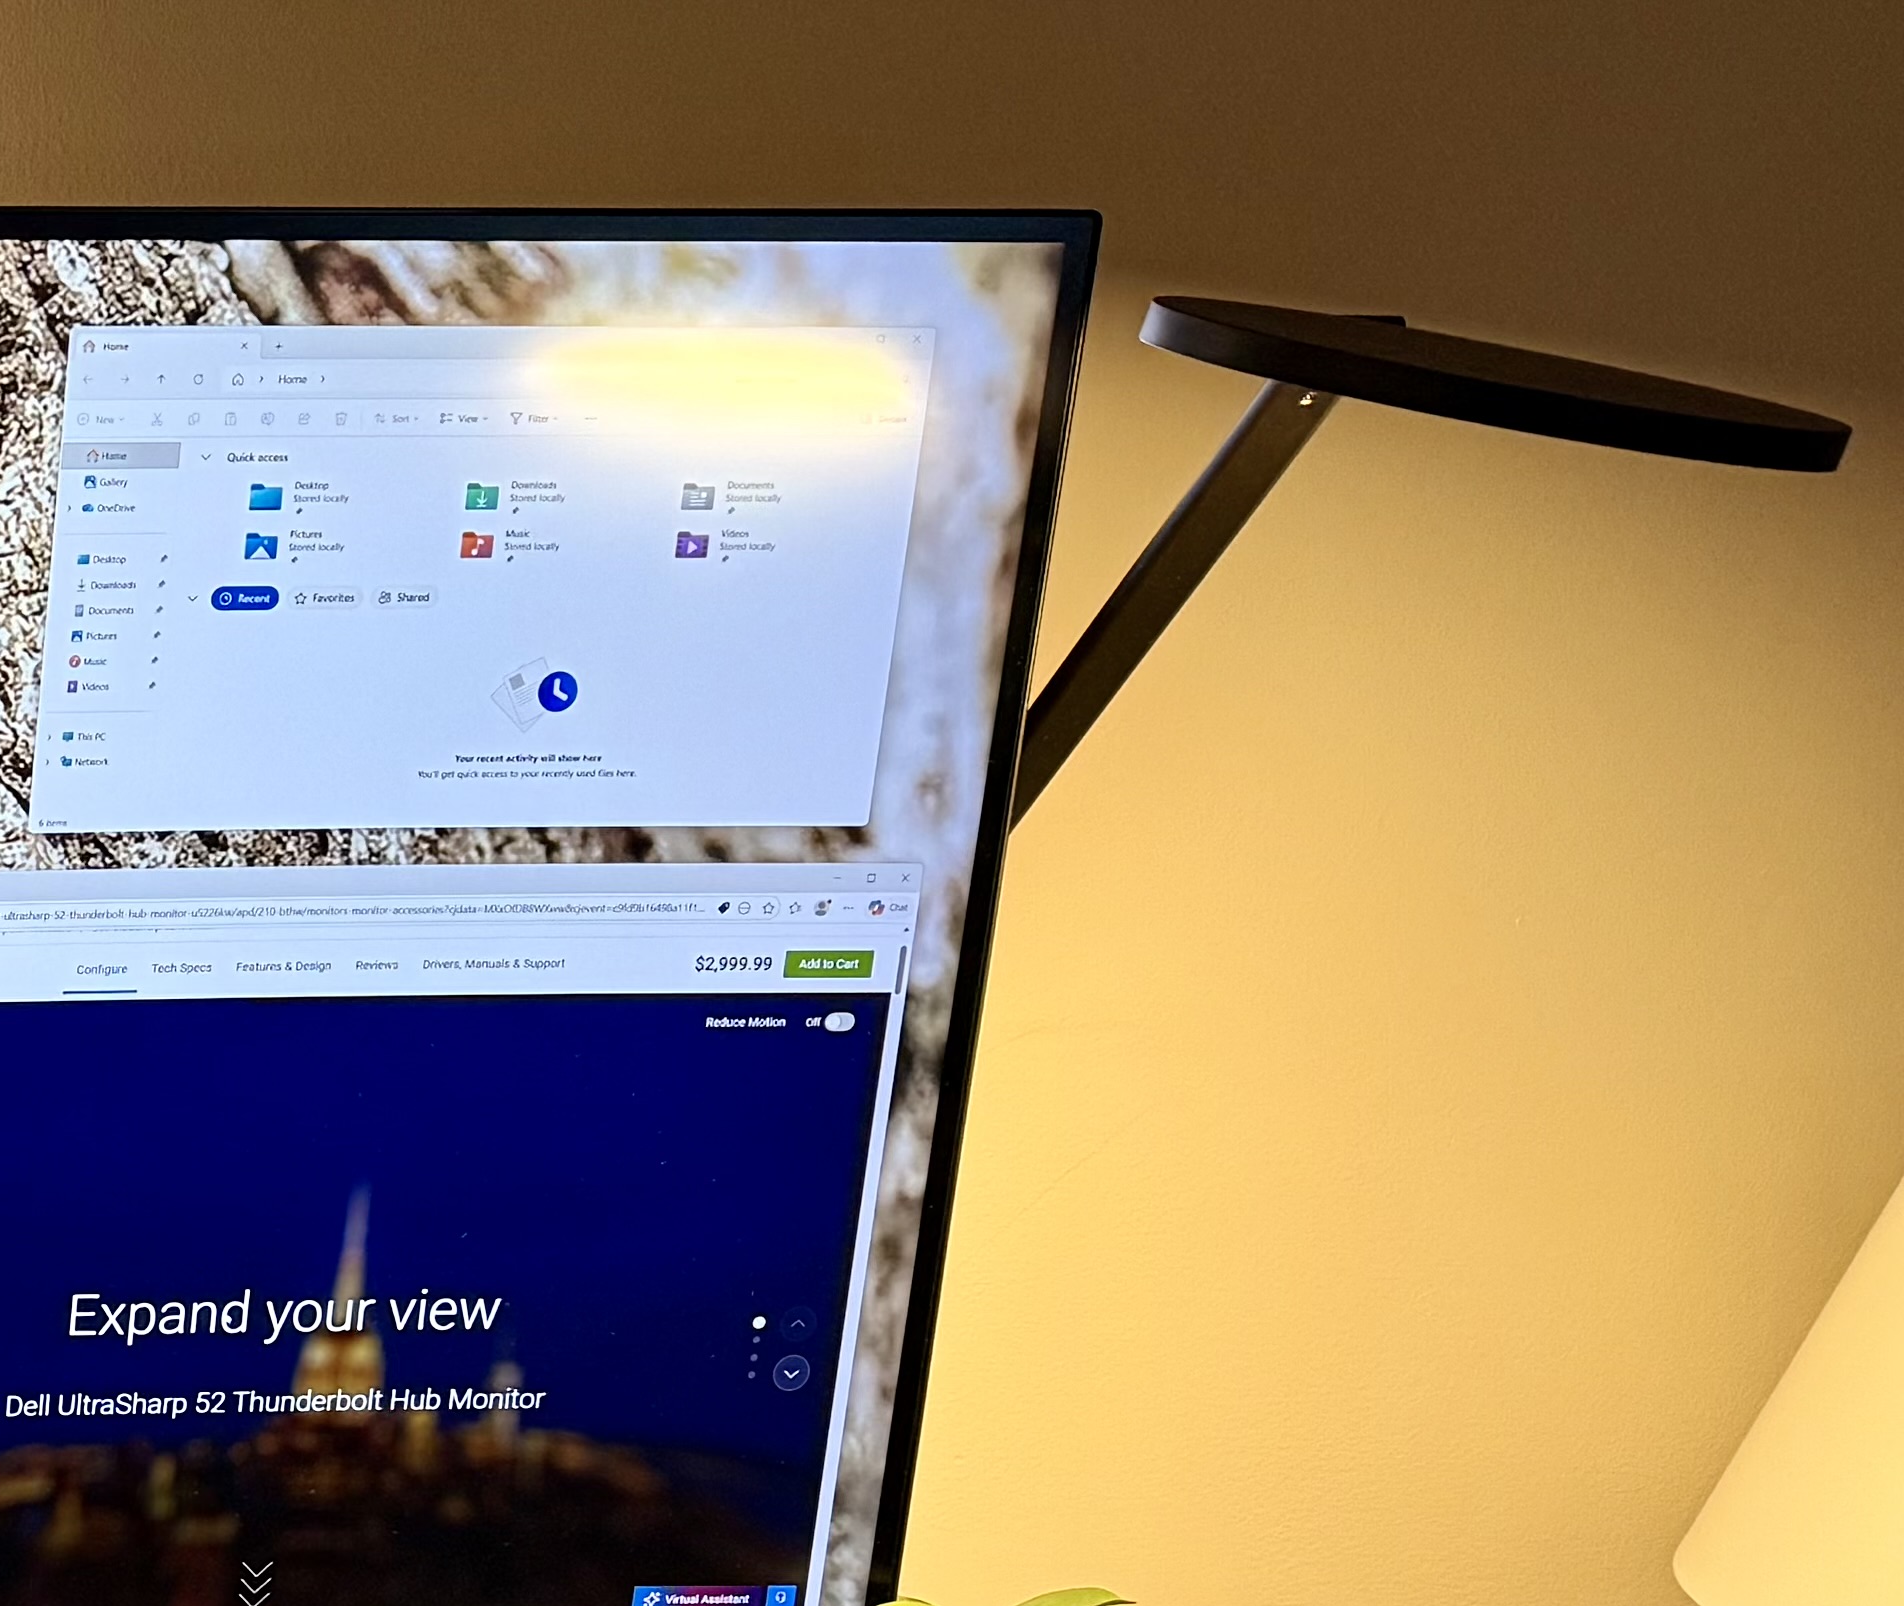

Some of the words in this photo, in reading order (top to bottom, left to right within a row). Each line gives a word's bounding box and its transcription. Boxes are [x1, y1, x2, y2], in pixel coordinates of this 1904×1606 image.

[278, 375, 307, 384] Home
[227, 453, 254, 462] Quick
[238, 594, 270, 603] Recent
[313, 593, 354, 602] Favorites
[397, 593, 429, 602] Shared
[423, 960, 461, 969] Drivers,
[465, 959, 509, 968] Manuals
[513, 959, 520, 968] &
[524, 959, 565, 970] Support
[695, 955, 772, 972] $2,999.99
[799, 958, 821, 969] Add
[823, 959, 834, 969] to
[836, 959, 859, 969] Cart
[69, 1289, 250, 1346] Expand
[264, 1297, 376, 1344] your
[390, 1289, 502, 1330] view
[6, 1394, 50, 1417] Dell
[58, 1392, 187, 1419] UltraSharp
[196, 1392, 225, 1413] 52
[233, 1387, 383, 1412] Thunderbolt
[390, 1389, 441, 1410] Hub
[449, 1387, 546, 1412] Monitor
